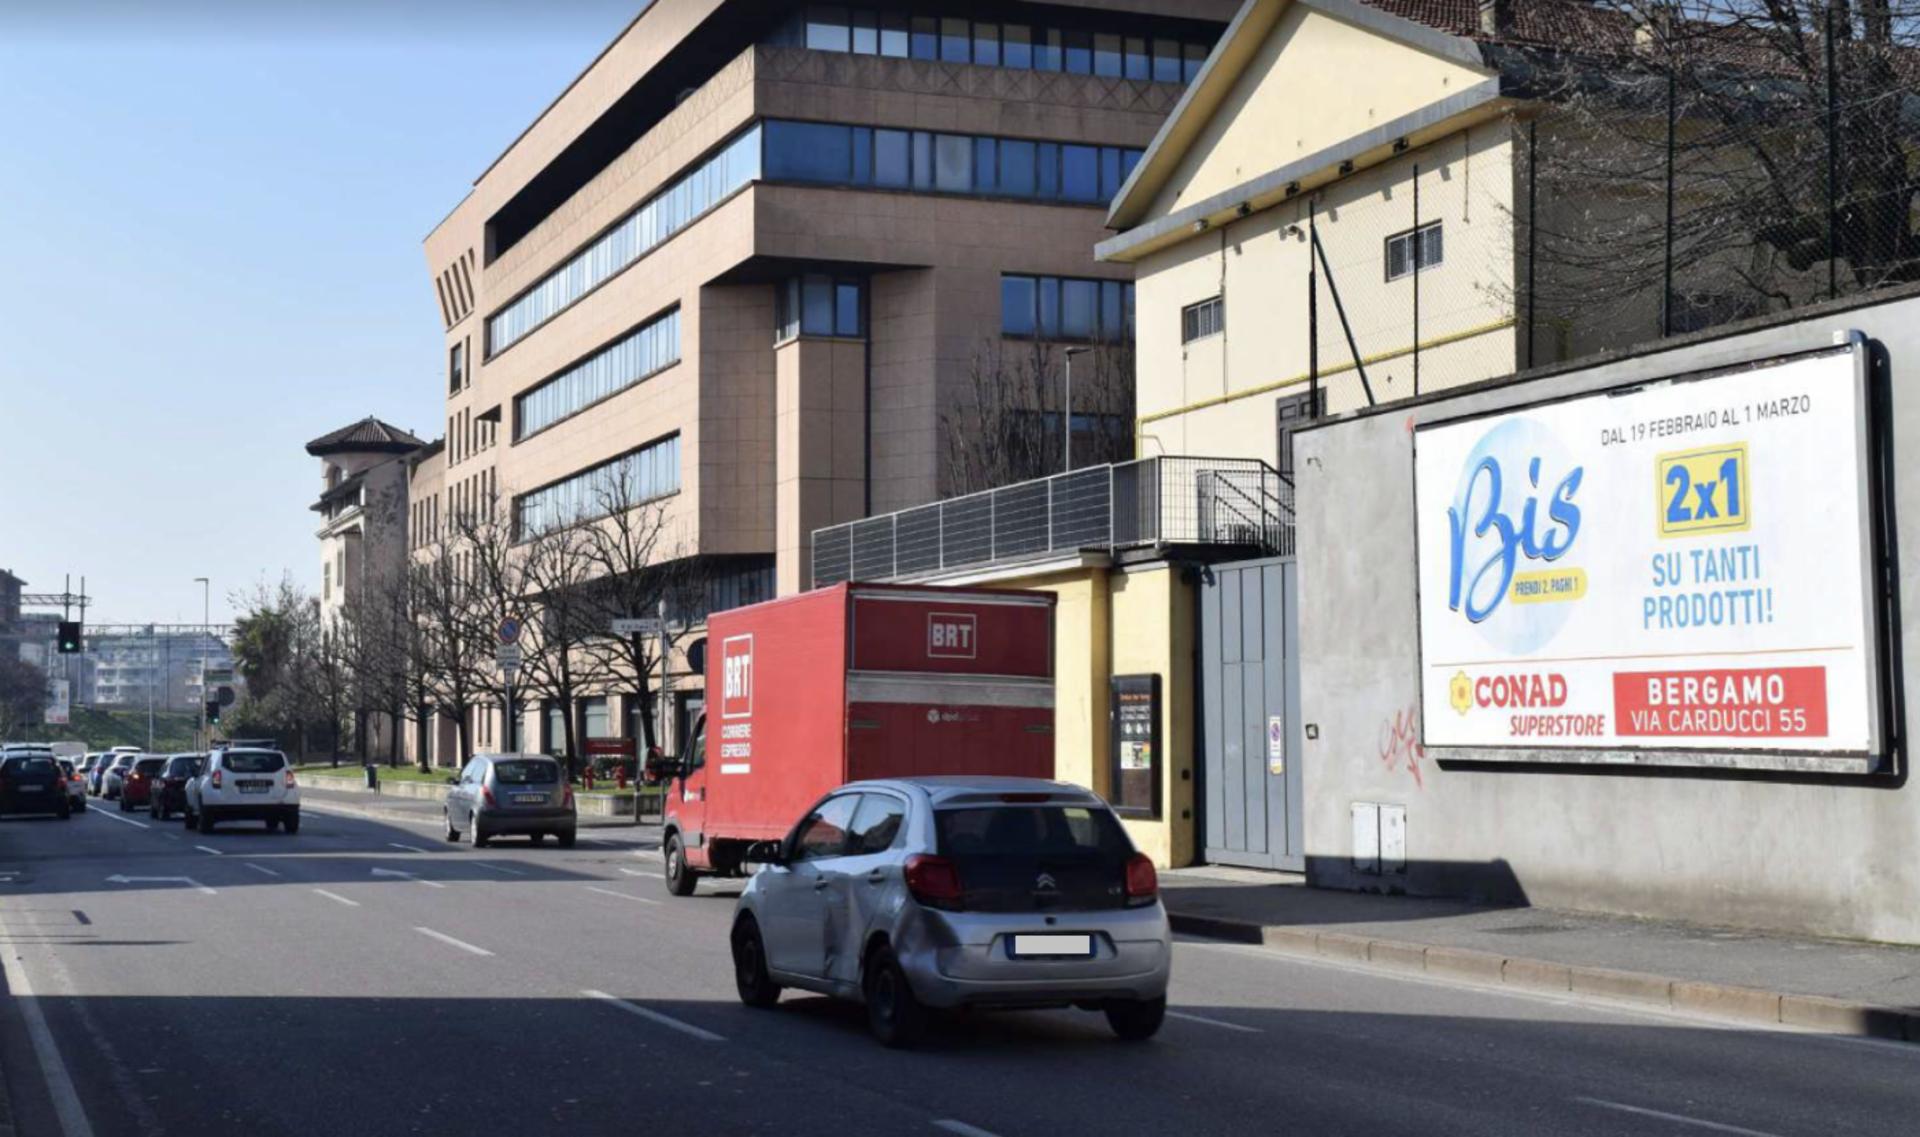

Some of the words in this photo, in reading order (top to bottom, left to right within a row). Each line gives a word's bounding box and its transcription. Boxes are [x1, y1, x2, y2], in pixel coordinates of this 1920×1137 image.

[1601, 429, 1627, 446] DAL
[1631, 423, 1645, 441] 19
[1650, 410, 1717, 439] FEBBRAIO
[1721, 409, 1740, 426] AL
[1745, 405, 1751, 423] 1
[1757, 394, 1811, 420] MARZO
[1665, 457, 1741, 524] 2x1
[1447, 456, 1584, 623] Bis
[1652, 552, 1682, 588] SU
[1691, 544, 1760, 583] TANTI
[1643, 589, 1774, 631] PRODOTTI!
[931, 623, 972, 648] BRT
[725, 654, 750, 699] BRT
[1474, 673, 1568, 709] CONAD
[1648, 674, 1785, 705] BERGAMO
[1509, 714, 1605, 737] SUPERSTORE
[1631, 711, 1666, 732] VIA
[1669, 708, 1771, 733] CARDUCCI
[1779, 708, 1807, 732] 55
